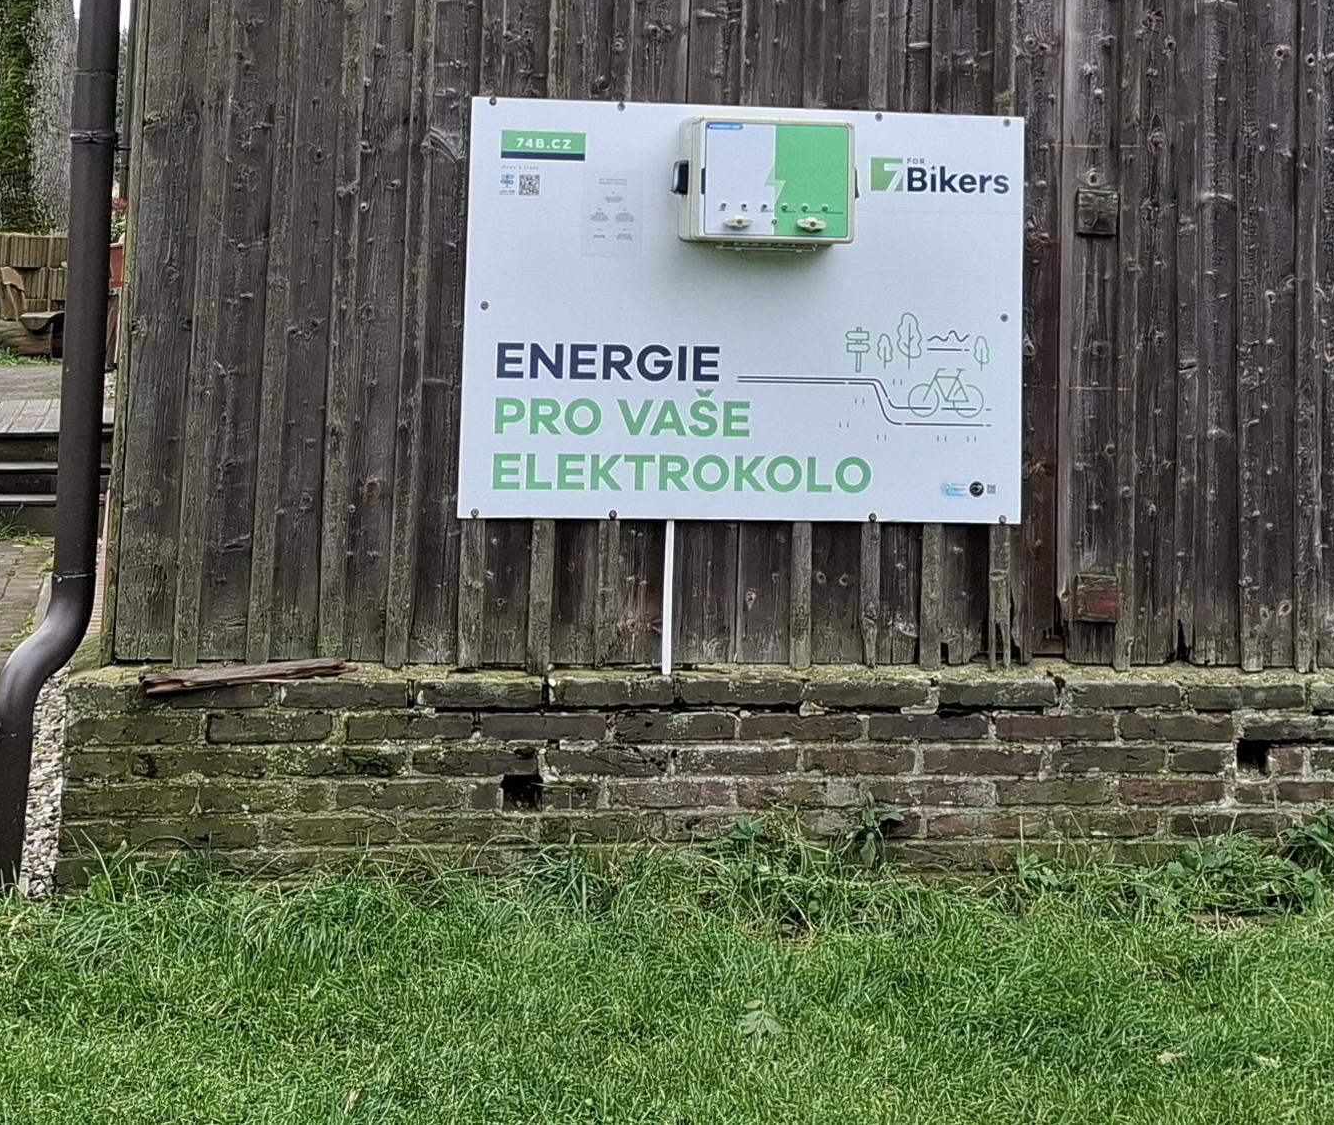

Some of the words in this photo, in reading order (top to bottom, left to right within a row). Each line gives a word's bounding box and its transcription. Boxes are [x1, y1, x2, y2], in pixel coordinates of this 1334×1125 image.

[516, 137, 572, 150] 74B.CZ
[907, 157, 926, 165] FOR
[907, 165, 1010, 195] Bikers
[496, 342, 721, 382] ENERGIE
[493, 397, 603, 436] PRO
[617, 389, 752, 438] VAŠE
[491, 453, 872, 494] ELEKTROKOLO
